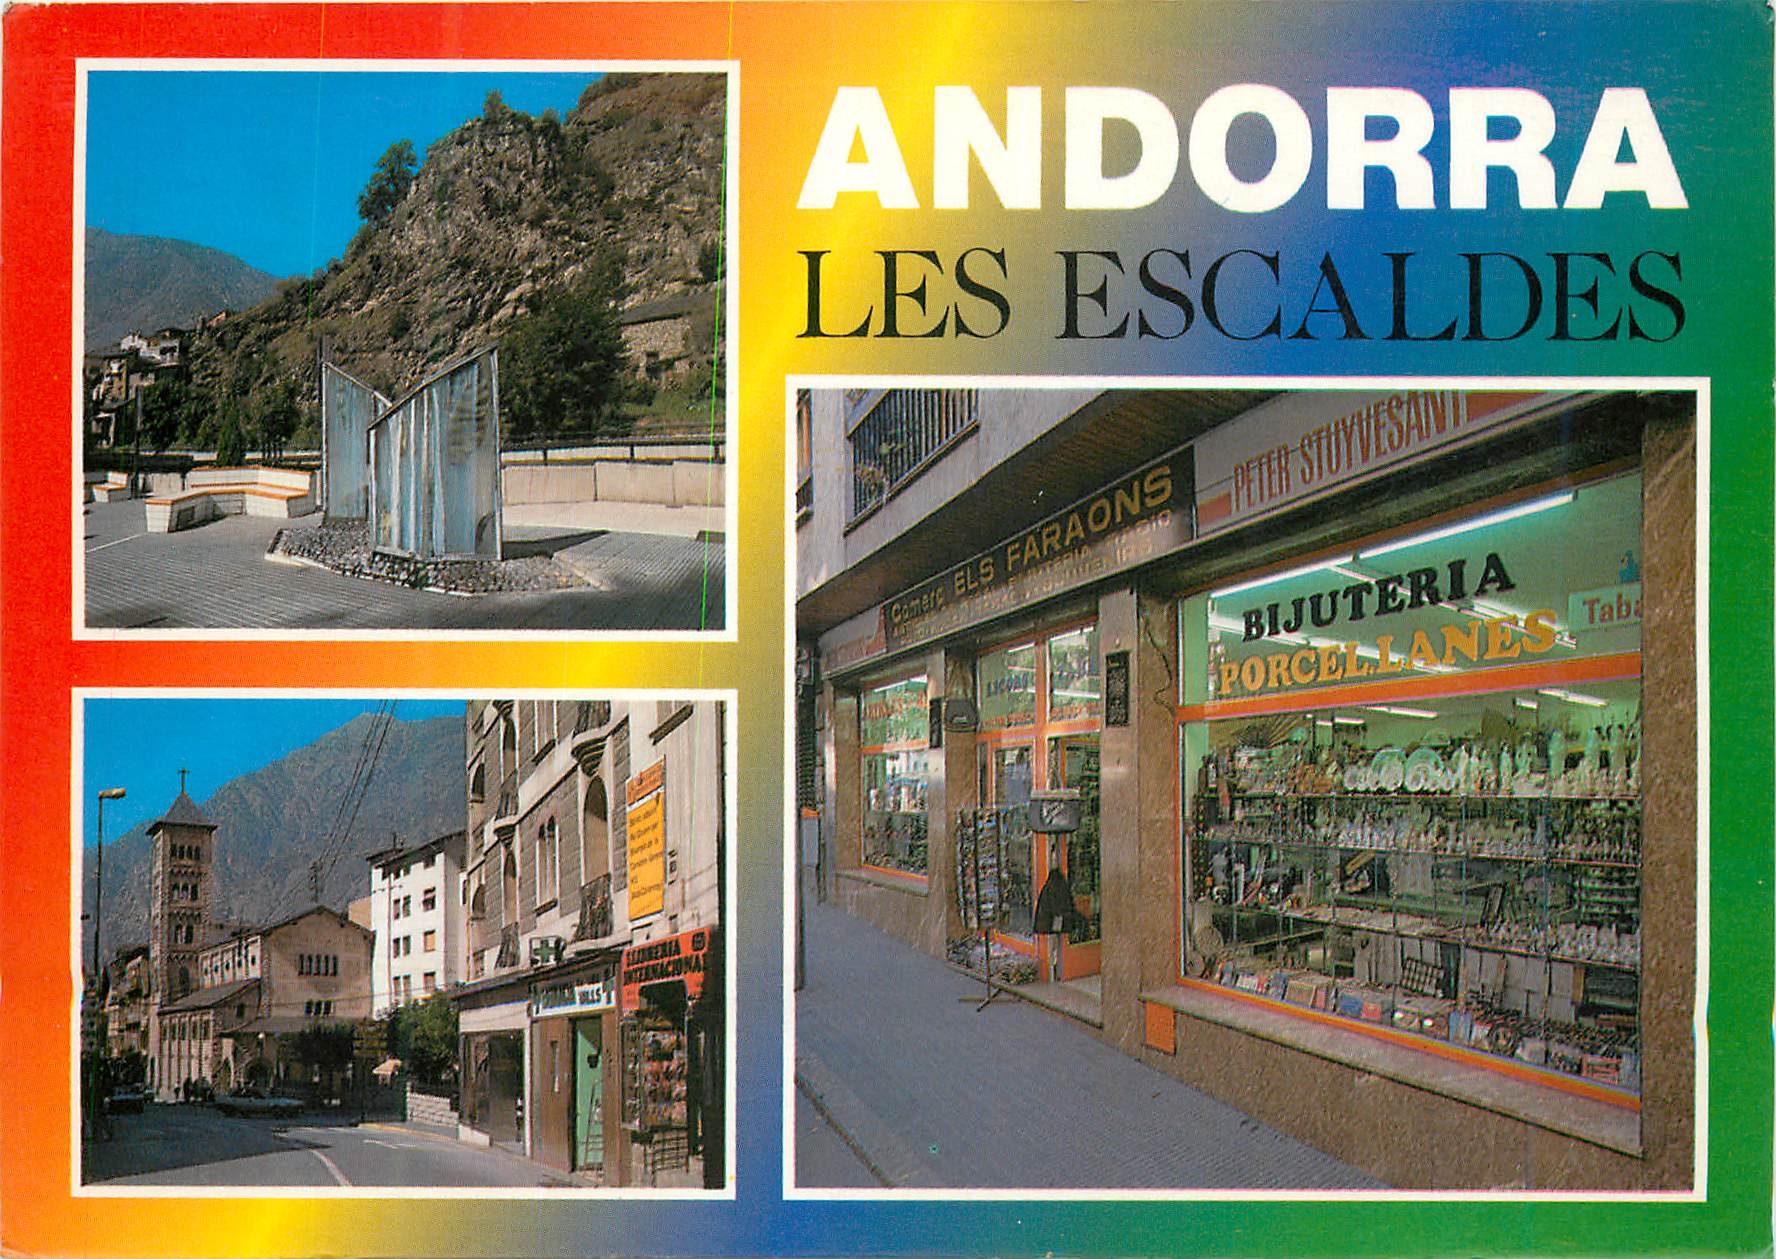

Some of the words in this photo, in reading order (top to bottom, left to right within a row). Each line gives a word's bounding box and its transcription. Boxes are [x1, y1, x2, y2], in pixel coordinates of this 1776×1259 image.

[1232, 442, 1292, 512] PETER
[953, 557, 995, 594] ELS
[1007, 465, 1174, 571] FARAONS
[1242, 552, 1516, 642] BIJUTERIA
